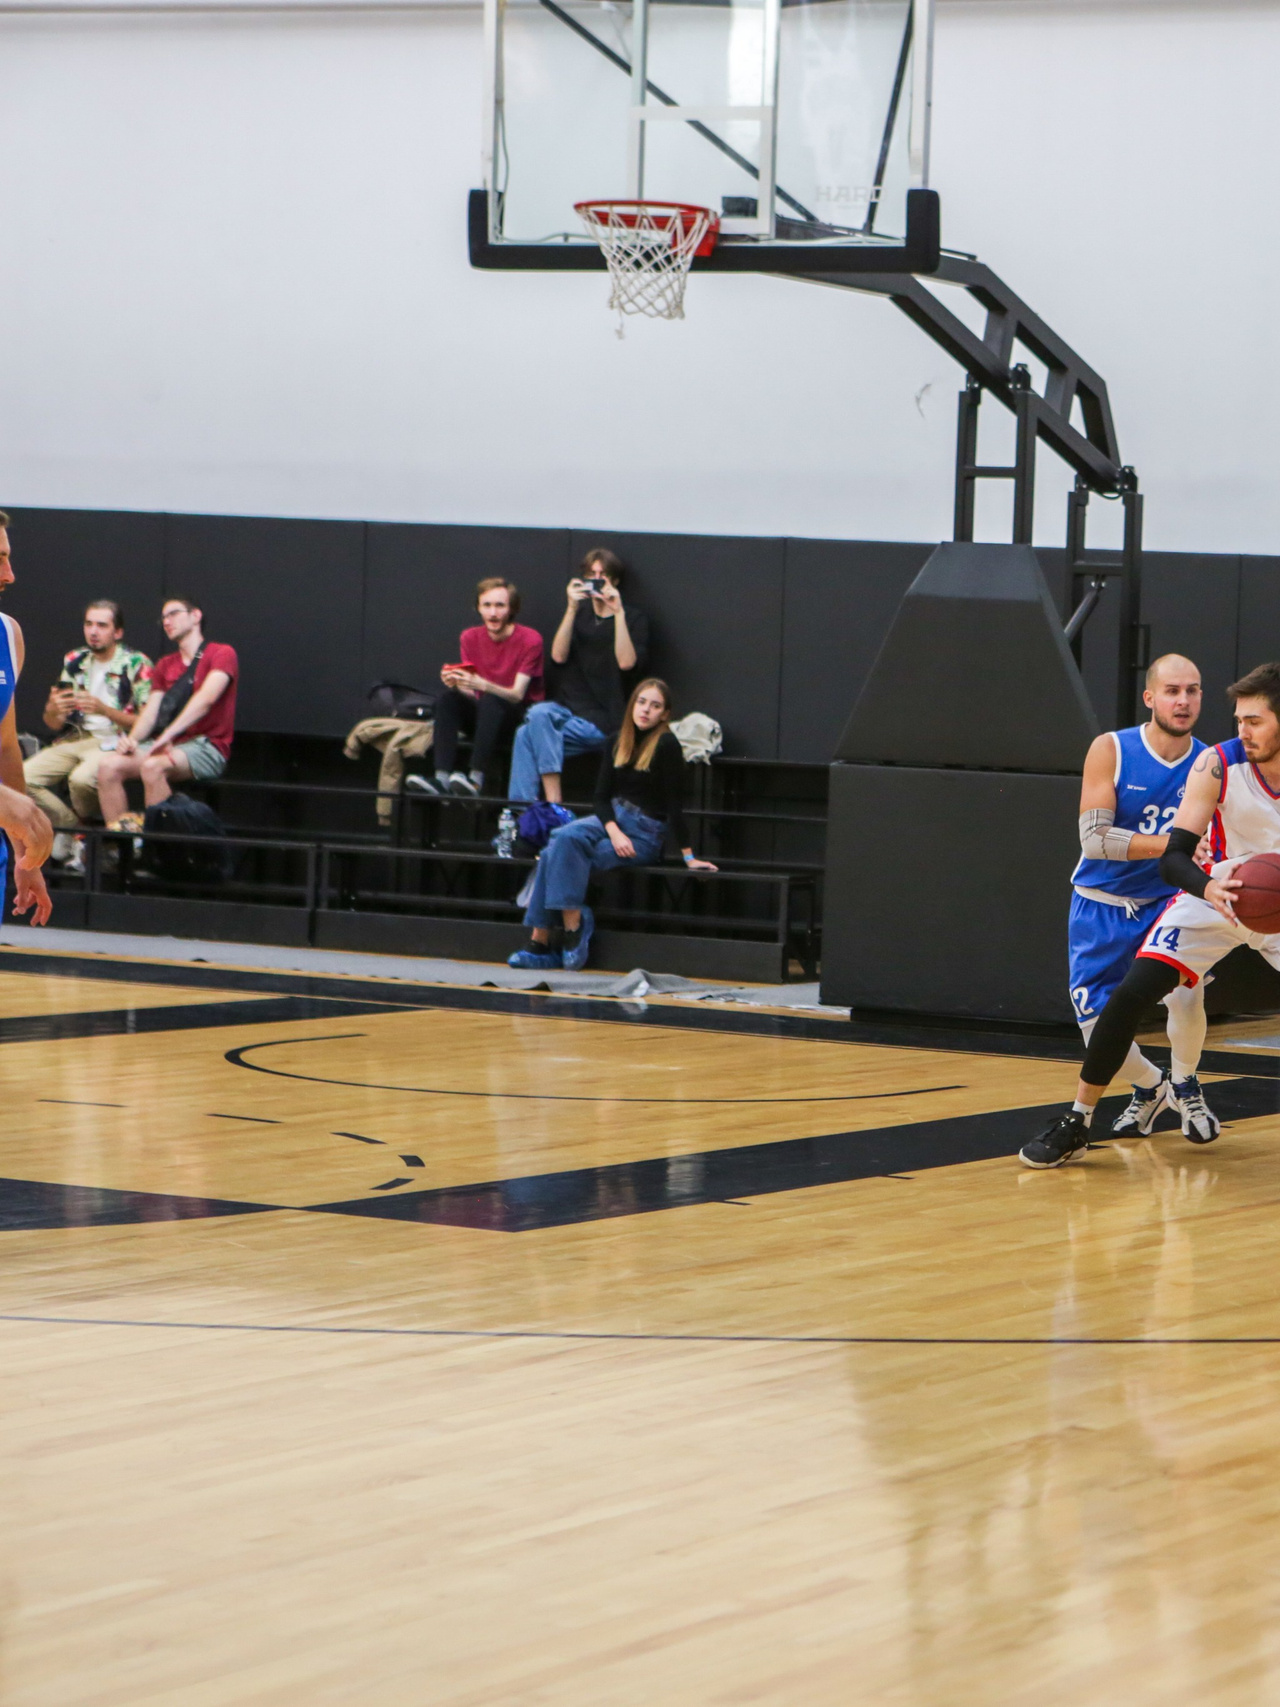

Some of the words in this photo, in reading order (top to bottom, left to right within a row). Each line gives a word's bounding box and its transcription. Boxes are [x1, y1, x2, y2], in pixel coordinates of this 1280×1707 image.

[1138, 804, 1178, 836] 32
[1148, 926, 1181, 952] 14
[1070, 986, 1094, 1018] 2
